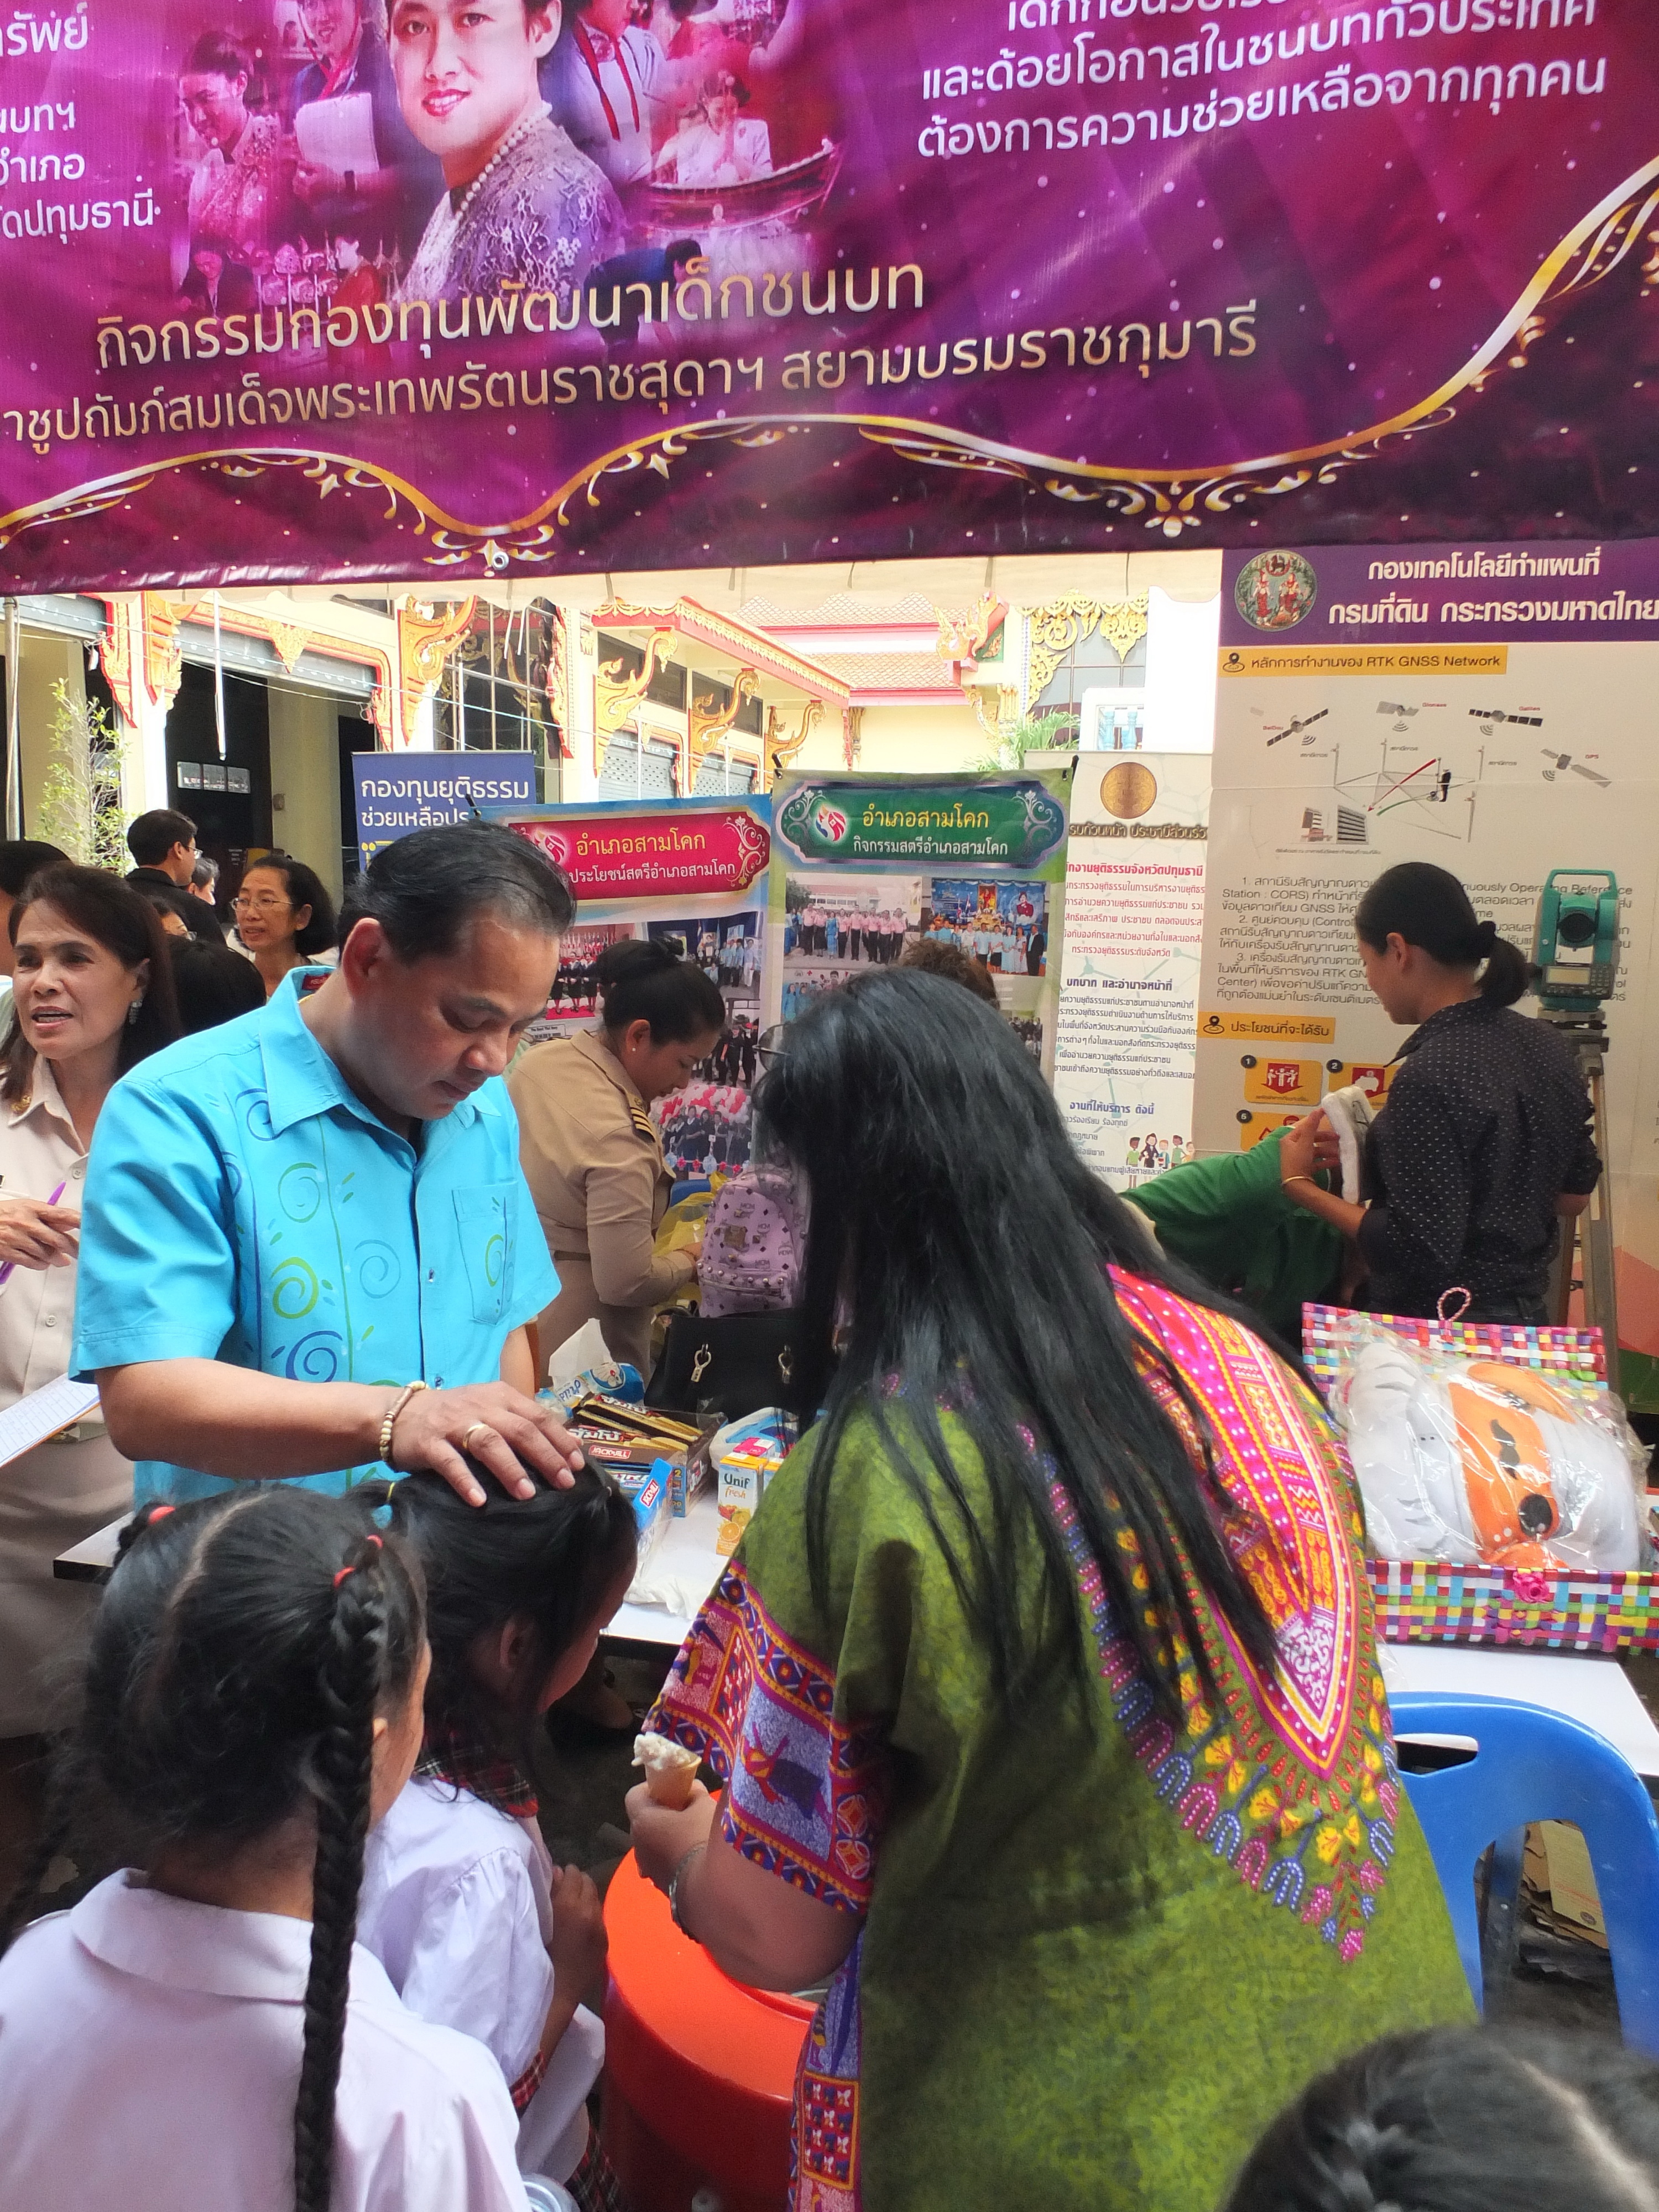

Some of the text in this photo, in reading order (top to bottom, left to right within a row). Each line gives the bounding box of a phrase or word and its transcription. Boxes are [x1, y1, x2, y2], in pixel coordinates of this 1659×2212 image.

[0, 2, 88, 56] รัพย์
[918, 58, 1607, 157] ต้องการความช่วยเหลือจากทุกคน
[0, 189, 154, 244] ดปทุมธานี
[97, 258, 924, 369] กิจกรรมกองทุนพัฒนาเด็กชนบท
[781, 300, 1257, 391] สยามบรมราชกุมารี
[1368, 546, 1601, 581] กองเทคโนโลยีทำแผนที่
[1328, 589, 1659, 625] กรมที่ดิน กระทรวงมหาดไทย
[1251, 654, 1501, 669] หลักการทำงานของ RTK GNSS Network
[361, 776, 529, 805] กองทุนยุติธรรม
[863, 803, 989, 828] อำเภอสามโคก
[576, 827, 706, 857] อำเภอสามโคก
[853, 835, 1008, 855] กิจกรรมสตรีอำเภอสามโคก
[1066, 862, 1203, 878] ักงานยุติธรรมจังหวัดปทุมธานี
[1222, 888, 1261, 899] Station
[1270, 890, 1309, 901] CORS)
[1222, 901, 1297, 913] ข้อมูลดาวเทียม
[1301, 904, 1334, 913] GNSS
[1239, 915, 1248, 924] 2.
[1251, 914, 1310, 927] ศูนย์ควบคุม
[1237, 952, 1246, 961] 3.
[1323, 969, 1346, 978] RTK
[1067, 978, 1172, 991] บทบาท และอำนาจหน้าที่
[1218, 977, 1257, 988] Center)
[1058, 1008, 1194, 1021] ระทรวงยุติธรรมดำเนินงานด้านการให้บริการ
[1231, 1020, 1329, 1036] ประโยชน์ที่จะได้รับ
[1070, 1099, 1155, 1115] งานที่ให้บริการ ดังนี้
[724, 1473, 750, 1489] Unif
